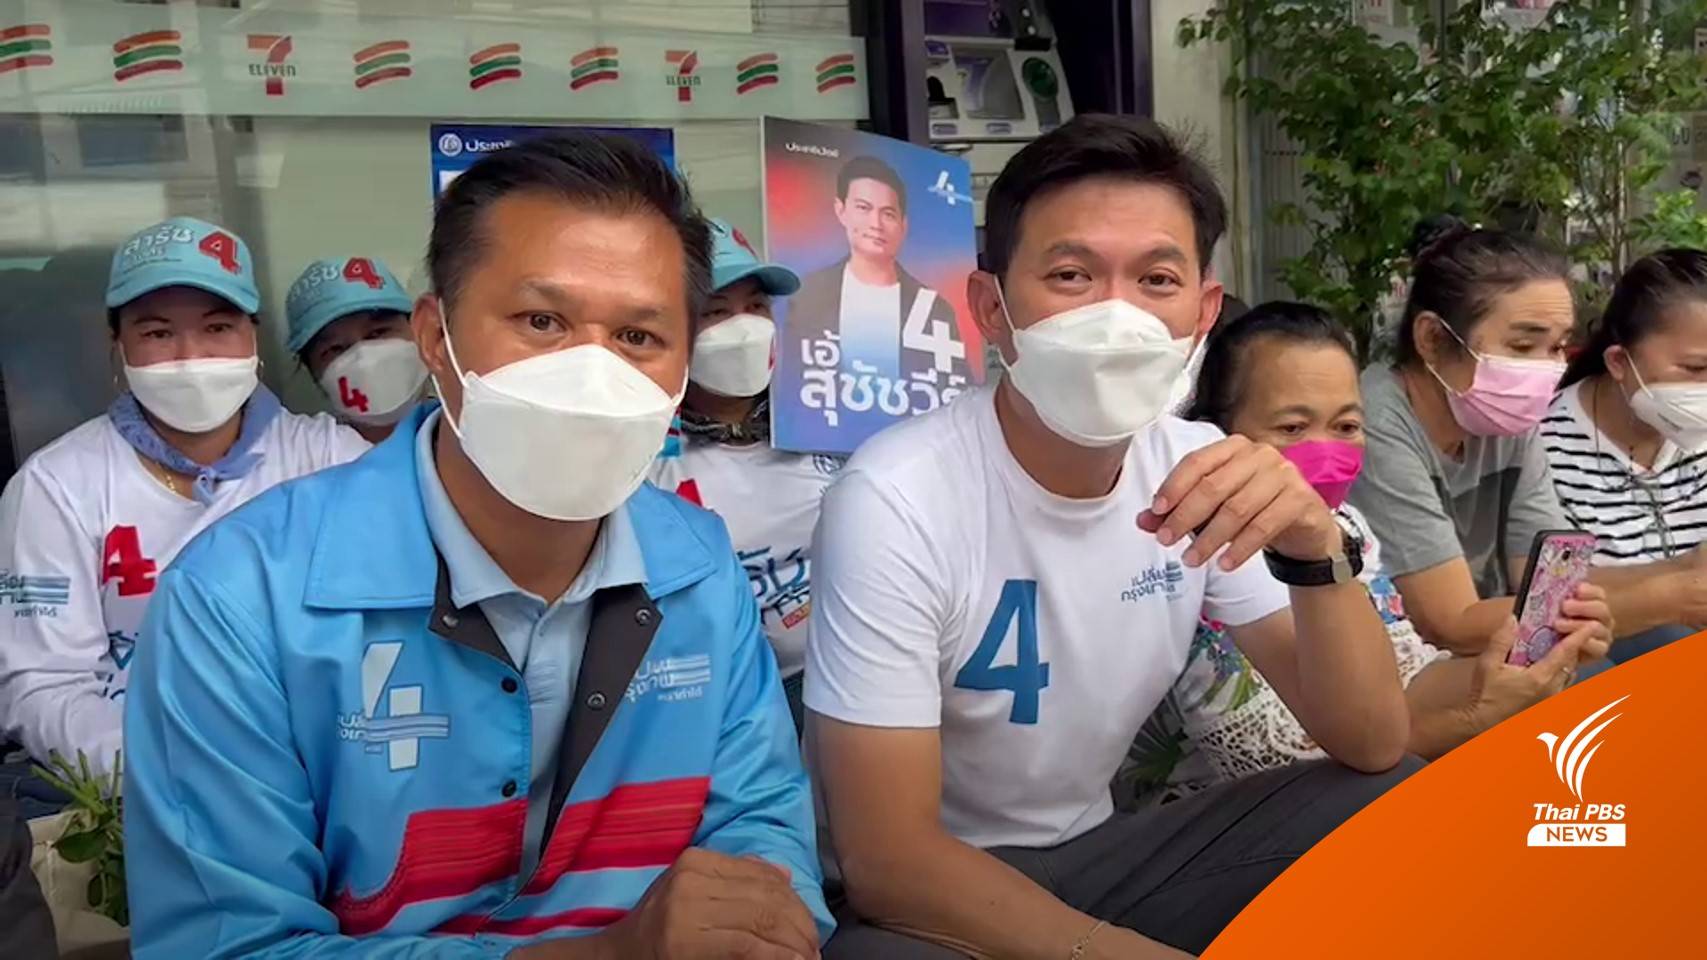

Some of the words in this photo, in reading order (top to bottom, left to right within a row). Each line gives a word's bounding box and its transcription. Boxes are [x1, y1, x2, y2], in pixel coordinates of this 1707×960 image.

[902, 287, 966, 373] 4
[102, 525, 157, 597] 4
[954, 579, 1050, 725] 4
